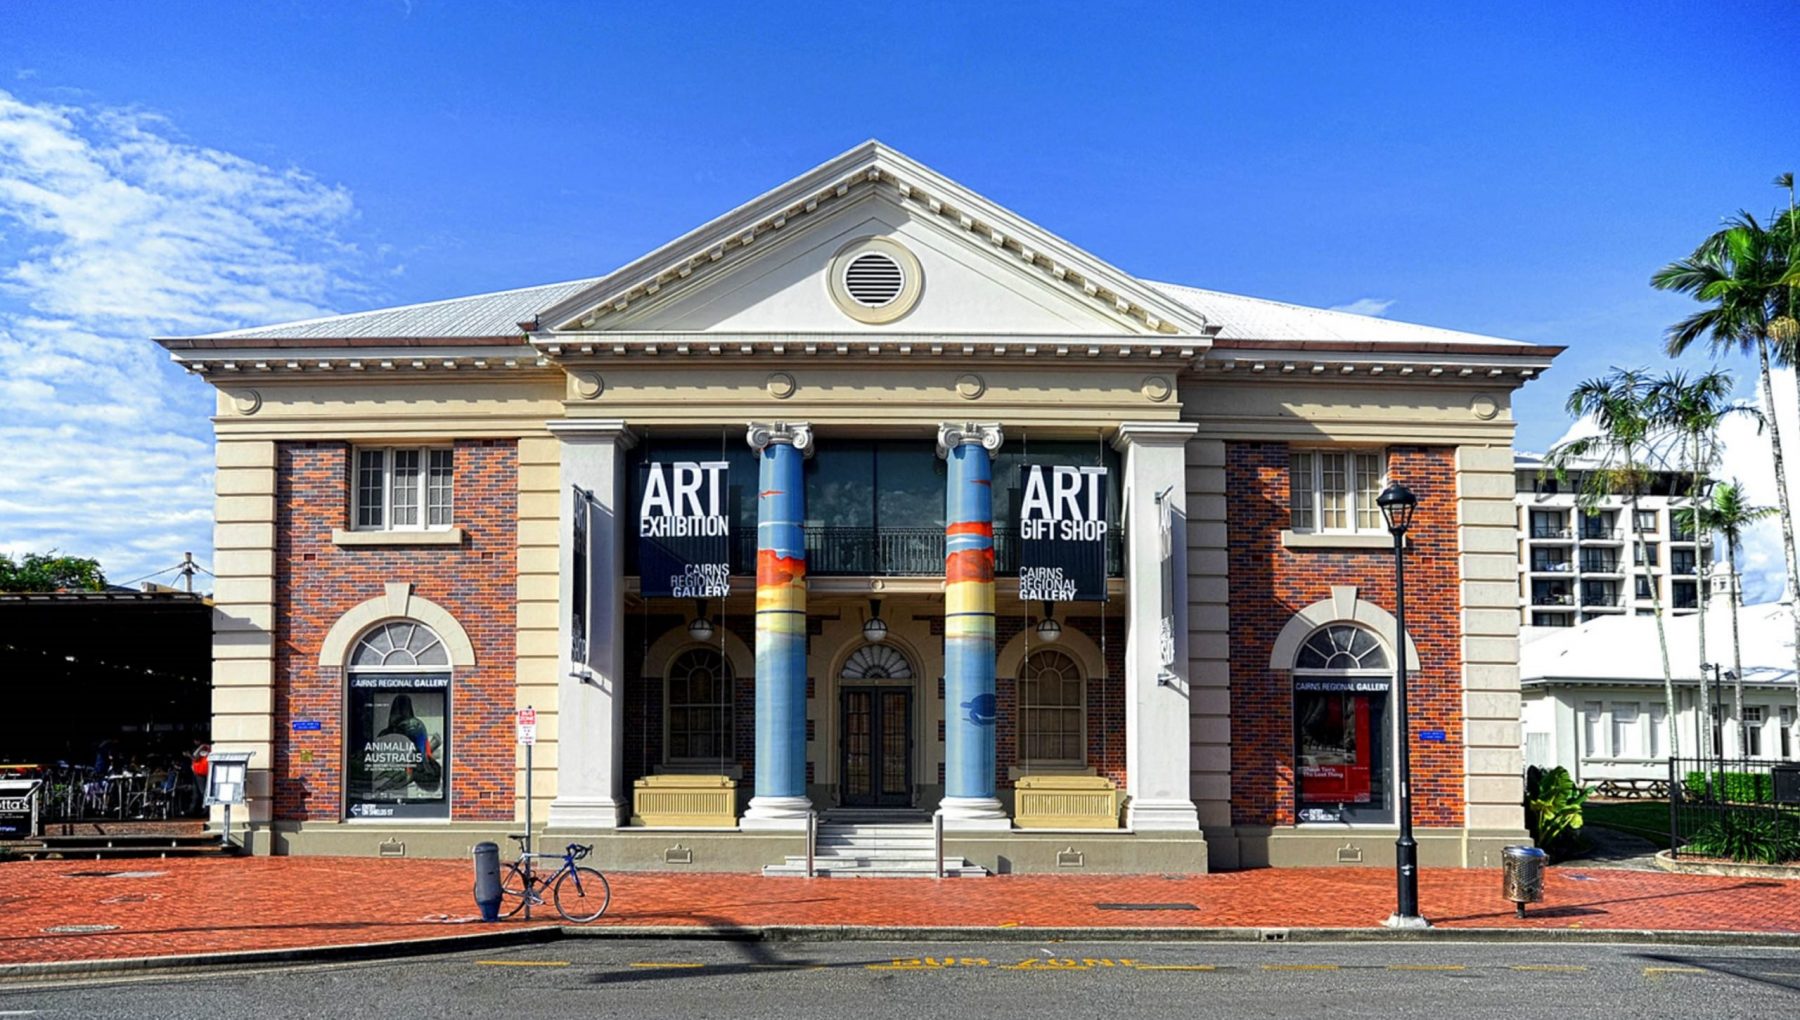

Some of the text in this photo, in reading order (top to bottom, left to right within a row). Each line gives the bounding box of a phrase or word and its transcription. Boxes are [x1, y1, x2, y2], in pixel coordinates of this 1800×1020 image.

[640, 461, 730, 517] ART
[1020, 465, 1108, 520] ART
[640, 515, 729, 538] EXHIBITION
[1020, 518, 1108, 541] GIFT SHOP
[684, 563, 730, 576] CAIRNS
[1019, 566, 1063, 580] CAIRNS
[670, 574, 729, 588] REGIONAL
[1019, 578, 1075, 591] REGIONAL
[672, 584, 730, 598] GALLERY
[1019, 588, 1078, 601] GALLERY
[351, 679, 449, 688] CAIRNS REGIONAL GALLERY
[1296, 682, 1389, 691] CAIRNS REGIONAL GALLERY
[364, 742, 416, 752] ANIMALIA
[364, 752, 423, 763] AUSTRALIS
[0, 799, 29, 810] tta's
